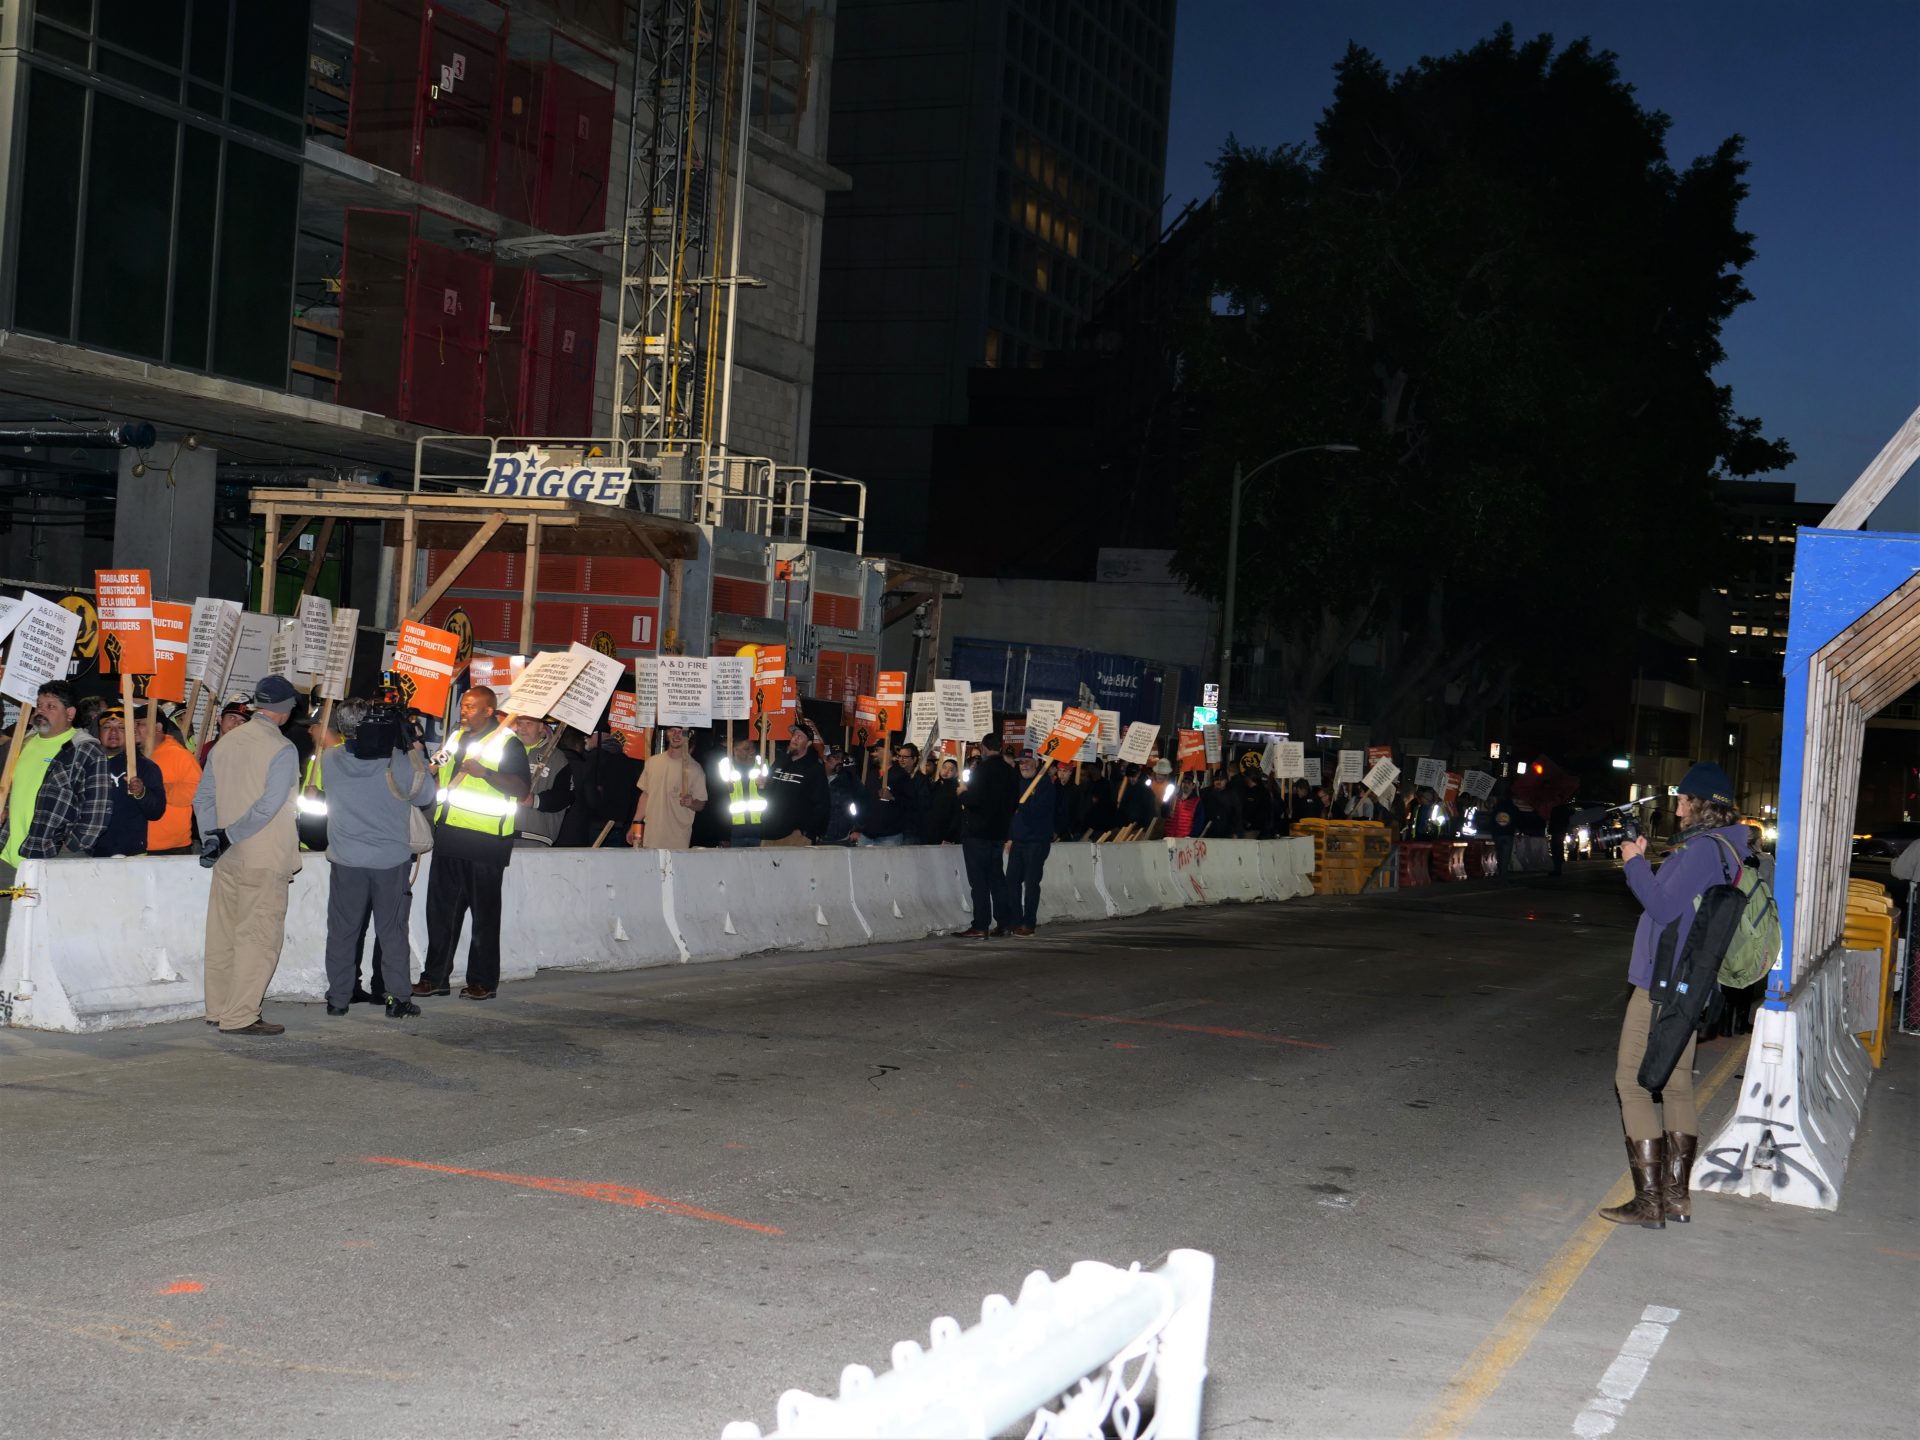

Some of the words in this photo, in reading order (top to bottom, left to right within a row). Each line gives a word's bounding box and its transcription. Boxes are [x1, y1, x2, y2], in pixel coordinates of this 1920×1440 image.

[443, 67, 451, 90] 3
[100, 574, 129, 584] TRABAJOS
[130, 574, 140, 583] DE
[100, 584, 145, 595] CONSTRUCCIÓN
[100, 597, 108, 606] DE
[108, 597, 116, 606] LA
[115, 595, 137, 607] UNIÓN
[38, 606, 54, 617] A&D
[54, 612, 67, 624] FIRE
[101, 609, 116, 617] PARA
[31, 616, 45, 627] DOES
[45, 621, 56, 632] NOT
[102, 621, 141, 631] OAKLANDERS
[406, 625, 426, 637] UNION
[636, 616, 644, 641] 1
[27, 625, 36, 633] ITS
[36, 627, 64, 646] EMPLOYEES
[20, 630, 29, 640] THE
[29, 634, 43, 646] AREA
[43, 641, 67, 657] STANDARD
[401, 645, 418, 655] JOBS
[403, 635, 452, 654] CONSTRUCTION
[23, 642, 55, 661] ESTABLISHED
[400, 653, 412, 663] FOR
[21, 651, 34, 661] THIS
[34, 656, 47, 666] AREA
[47, 661, 56, 671] FOR
[678, 661, 684, 669] D
[687, 662, 708, 670] FIRE
[19, 659, 40, 672] SIMILAR
[41, 667, 55, 679] WORK
[397, 662, 440, 680] OAKLANDERS
[475, 678, 491, 686] JOBS
[616, 694, 633, 702] UNION
